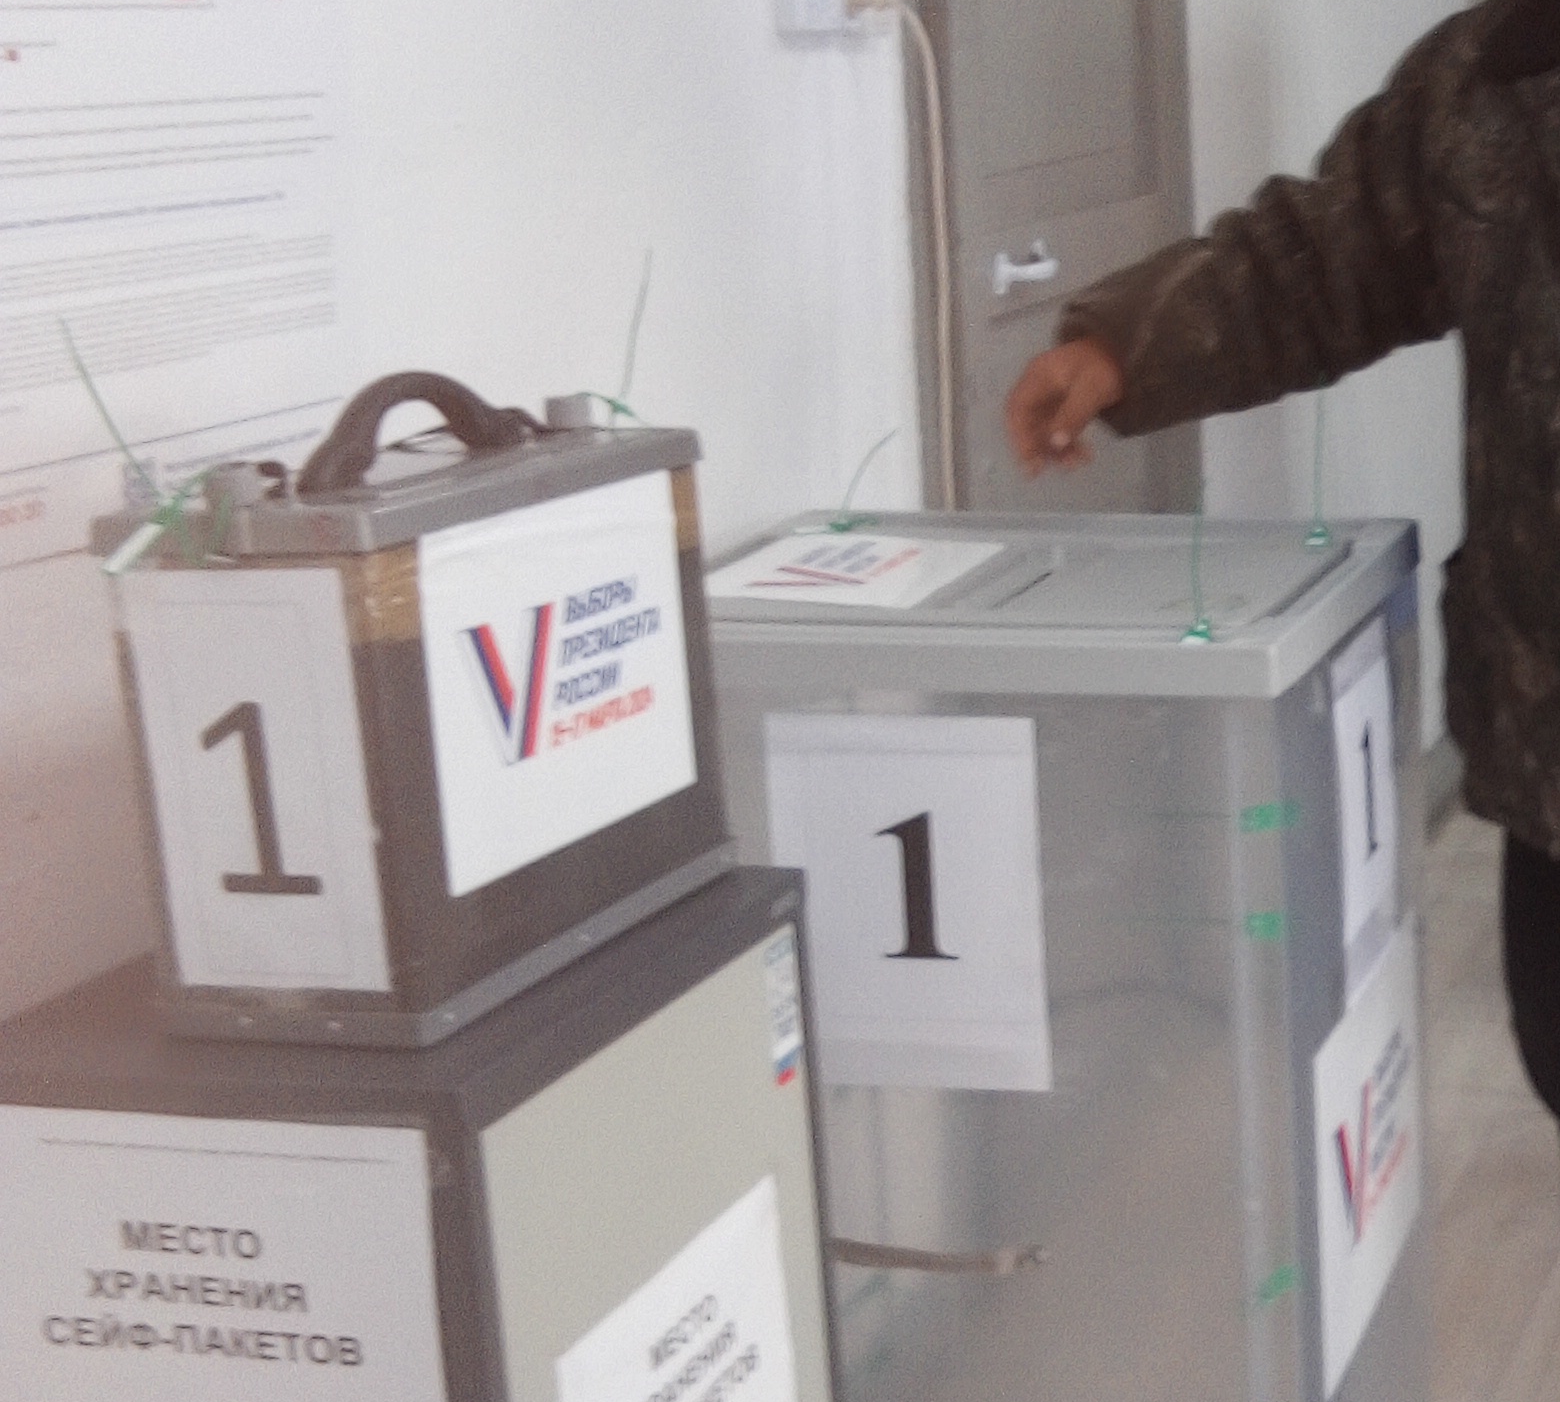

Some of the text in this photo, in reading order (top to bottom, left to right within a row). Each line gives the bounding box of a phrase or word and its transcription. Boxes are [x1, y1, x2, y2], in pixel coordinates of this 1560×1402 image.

[200, 701, 323, 896] 1
[873, 810, 959, 961] 1
[119, 1220, 263, 1259] МЕСТО
[86, 1268, 309, 1313] ХРАНЕНИЯ
[43, 1314, 364, 1366] СЕЙФ-ПАКЕТОВ
